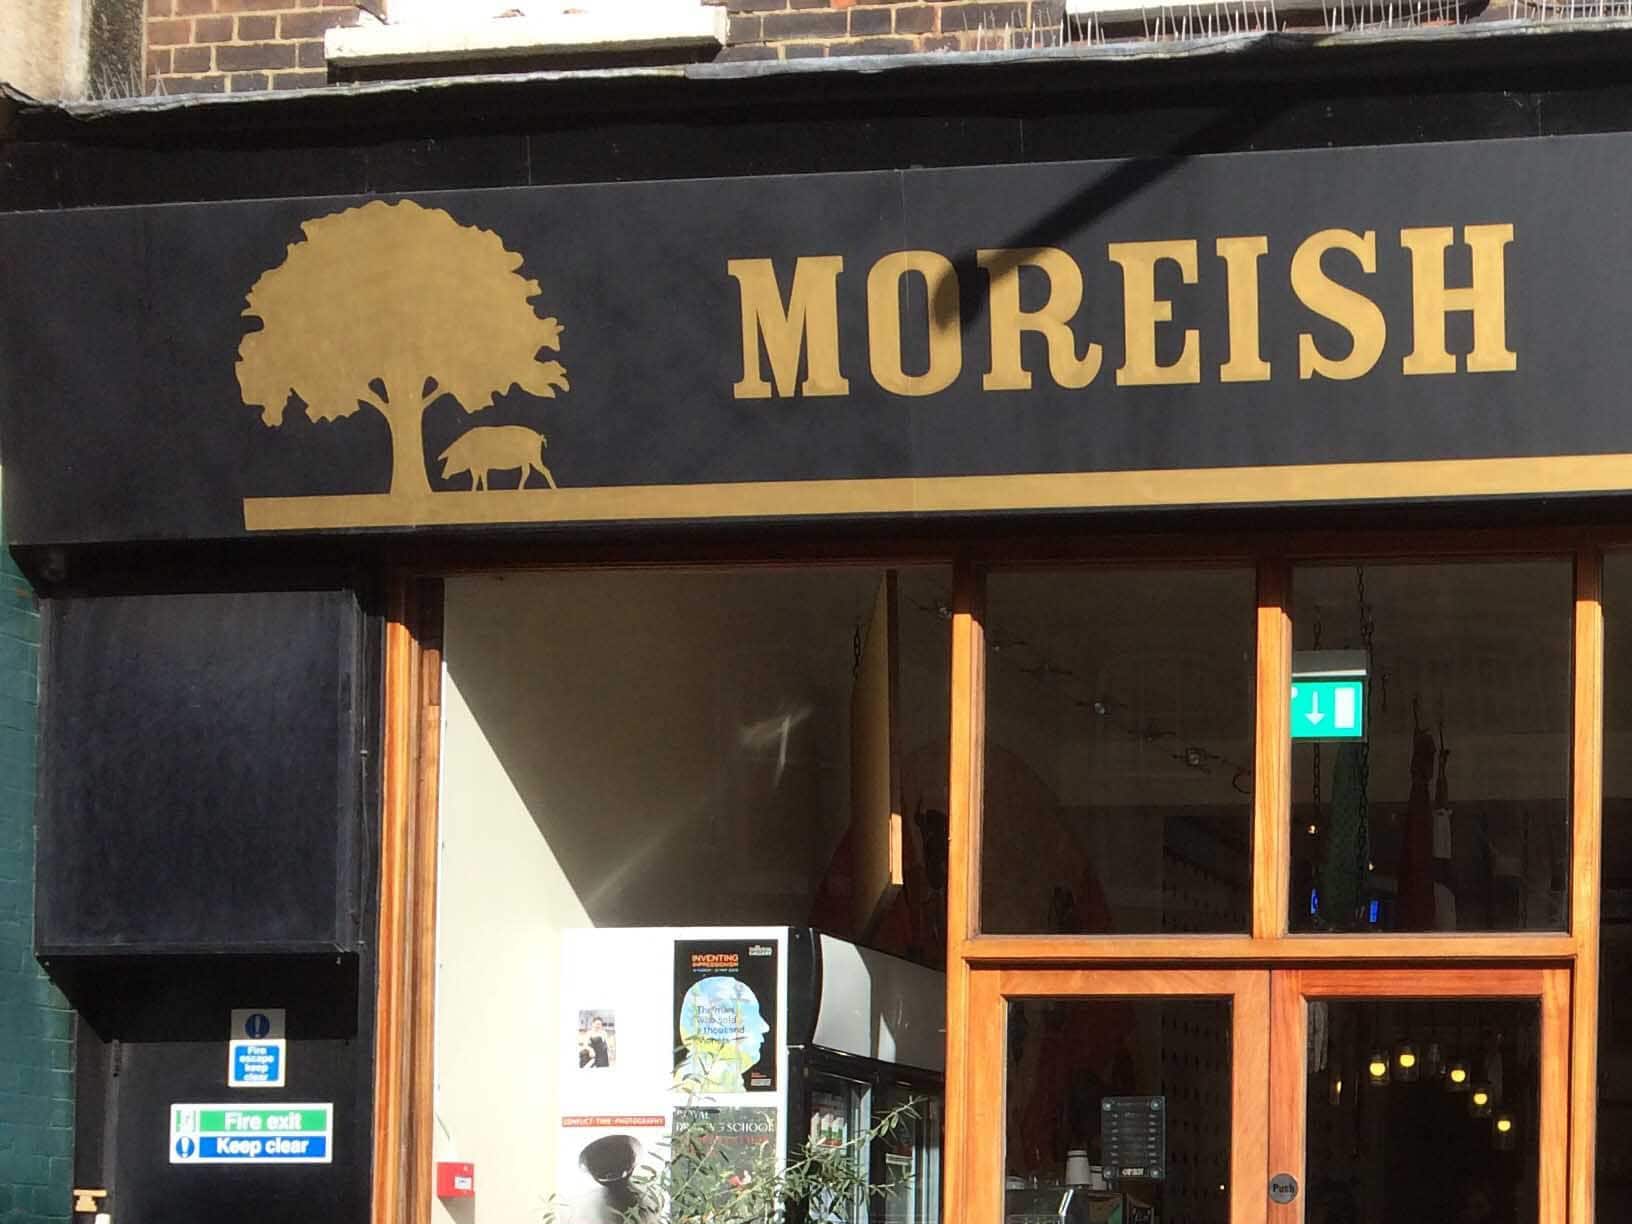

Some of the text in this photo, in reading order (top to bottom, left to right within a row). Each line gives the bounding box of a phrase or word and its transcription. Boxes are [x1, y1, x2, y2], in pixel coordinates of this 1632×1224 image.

[727, 223, 1517, 399] MOREISH
[225, 1112, 302, 1130] Fire exit
[217, 1138, 309, 1157] Keep clear
